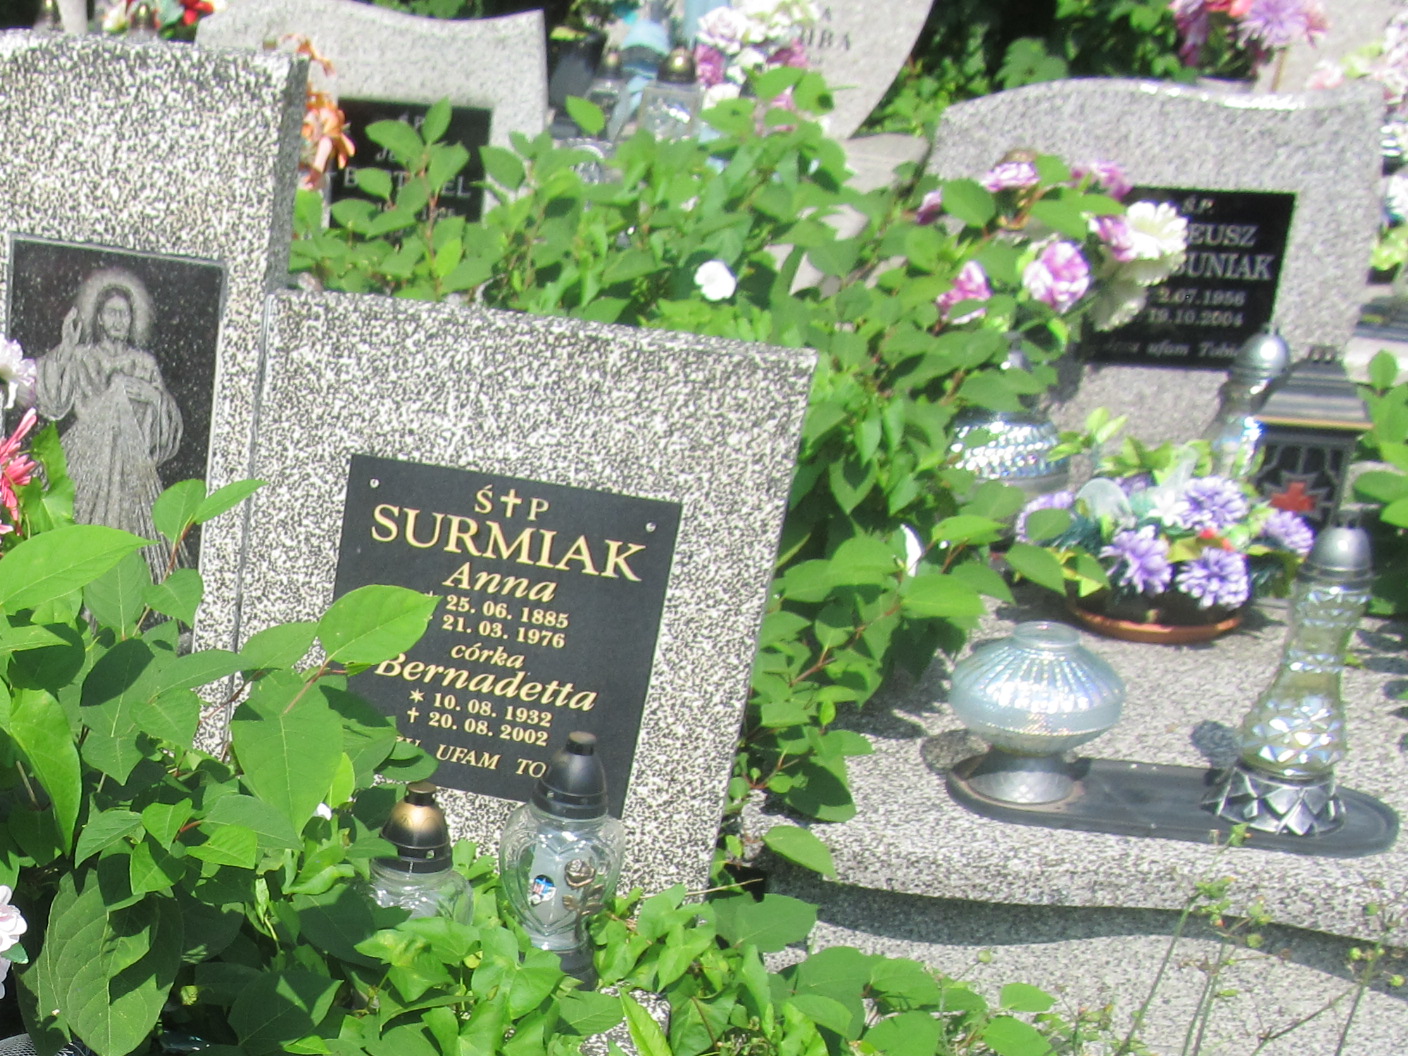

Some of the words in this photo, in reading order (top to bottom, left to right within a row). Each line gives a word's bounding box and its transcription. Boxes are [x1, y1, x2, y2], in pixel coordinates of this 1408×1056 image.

[1186, 223, 1259, 248] EUSZ
[371, 503, 647, 582] SURMIAK
[442, 561, 558, 603] Anna
[520, 607, 570, 629] 1885
[516, 627, 566, 649] 1976
[450, 642, 526, 669] córka
[374, 653, 598, 712] Bernadetta
[504, 705, 553, 728] 1932
[499, 724, 549, 747] 2002
[435, 744, 502, 770] UFAM
